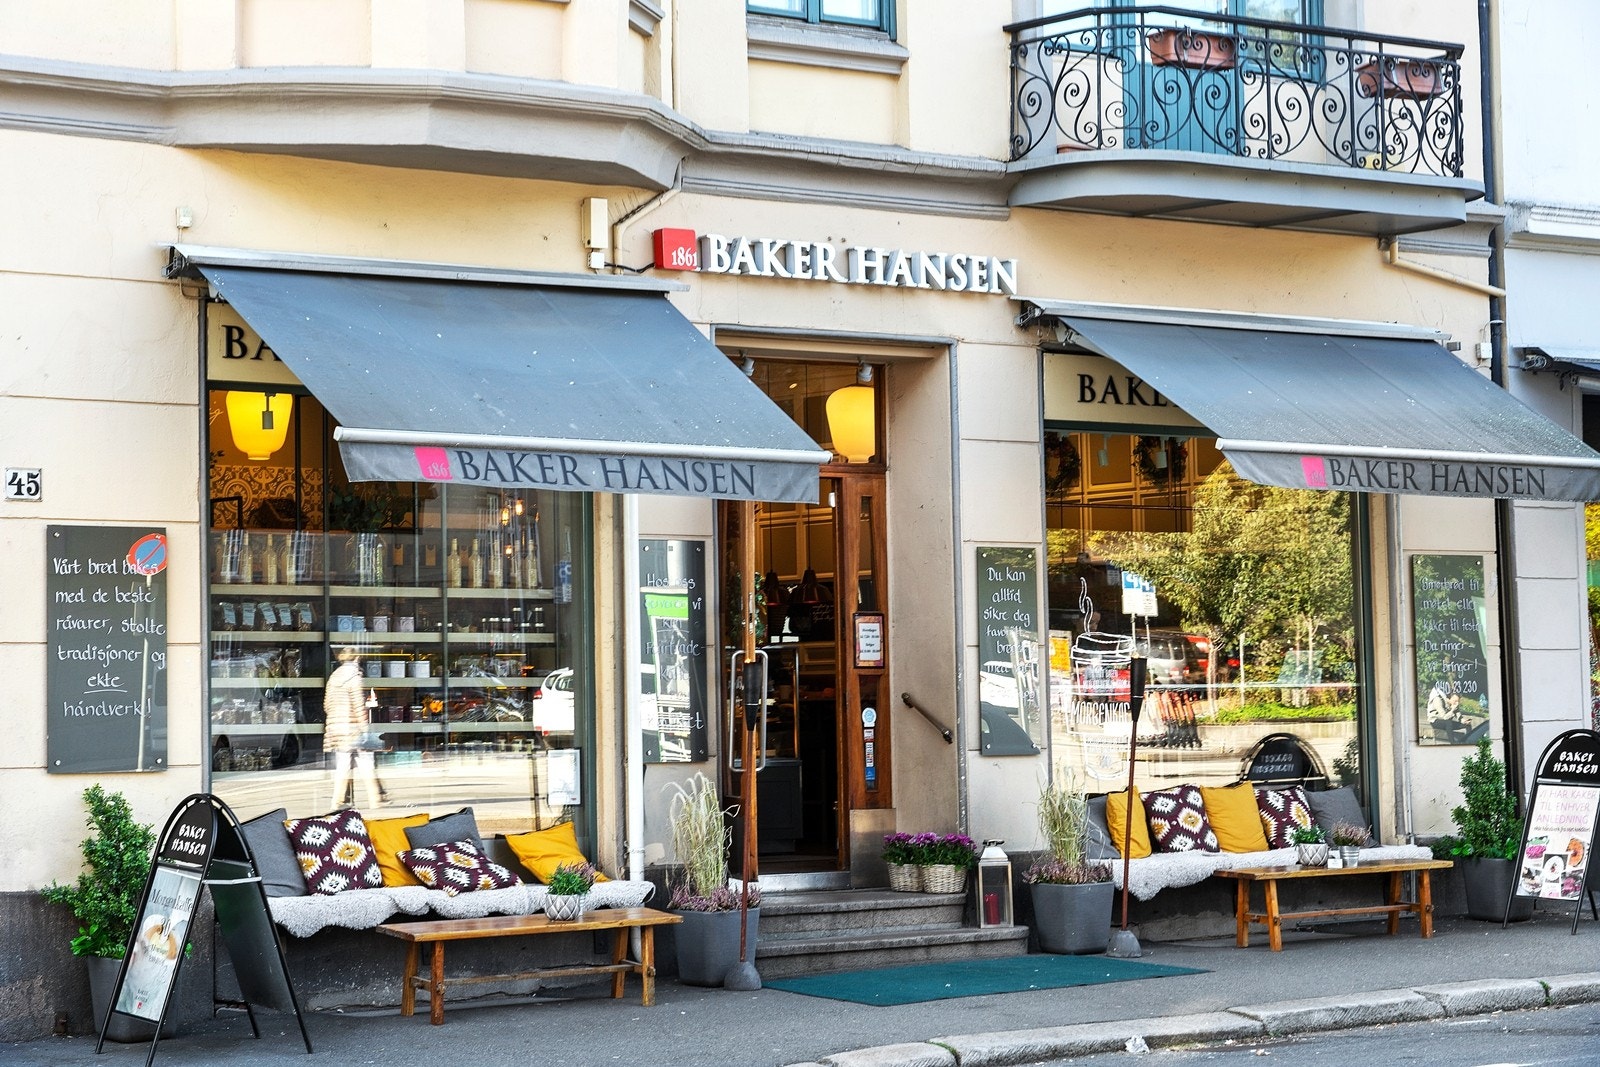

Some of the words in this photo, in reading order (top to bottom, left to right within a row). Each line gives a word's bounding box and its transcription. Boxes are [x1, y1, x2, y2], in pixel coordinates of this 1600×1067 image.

[671, 246, 697, 267] 1861
[705, 233, 850, 284] BAKER
[851, 245, 1018, 295] HANSEN
[1076, 373, 1179, 408] BAK
[453, 450, 591, 488] BAKER
[596, 457, 757, 496] HANSEN
[1328, 458, 1421, 491] BAKER
[1429, 462, 1546, 496] HANSEN
[8, 471, 41, 497] 45
[53, 557, 82, 575] Vårt
[88, 558, 118, 575] brød
[122, 559, 159, 575] bakes
[986, 567, 1003, 582] Du
[1006, 566, 1026, 582] kan
[647, 573, 668, 588] Hos
[1469, 578, 1480, 591] til
[55, 588, 86, 603] med
[92, 588, 110, 603] de
[114, 586, 156, 603] beste
[692, 597, 702, 610] vi
[992, 587, 1022, 604] alltid
[56, 614, 113, 635] råvarer,
[121, 617, 166, 635] stolte
[983, 606, 1010, 621] sikre
[1013, 609, 1031, 628] deg
[1449, 617, 1459, 632] til
[57, 644, 142, 668] tradisjoner
[151, 651, 166, 670] og
[646, 639, 701, 657] Firtade
[1423, 639, 1438, 653] Da
[1440, 639, 1464, 658] ringer
[87, 672, 125, 688] ekte
[1462, 680, 1478, 694] 230
[1549, 789, 1568, 799] HAR
[1571, 789, 1597, 800] KAKER
